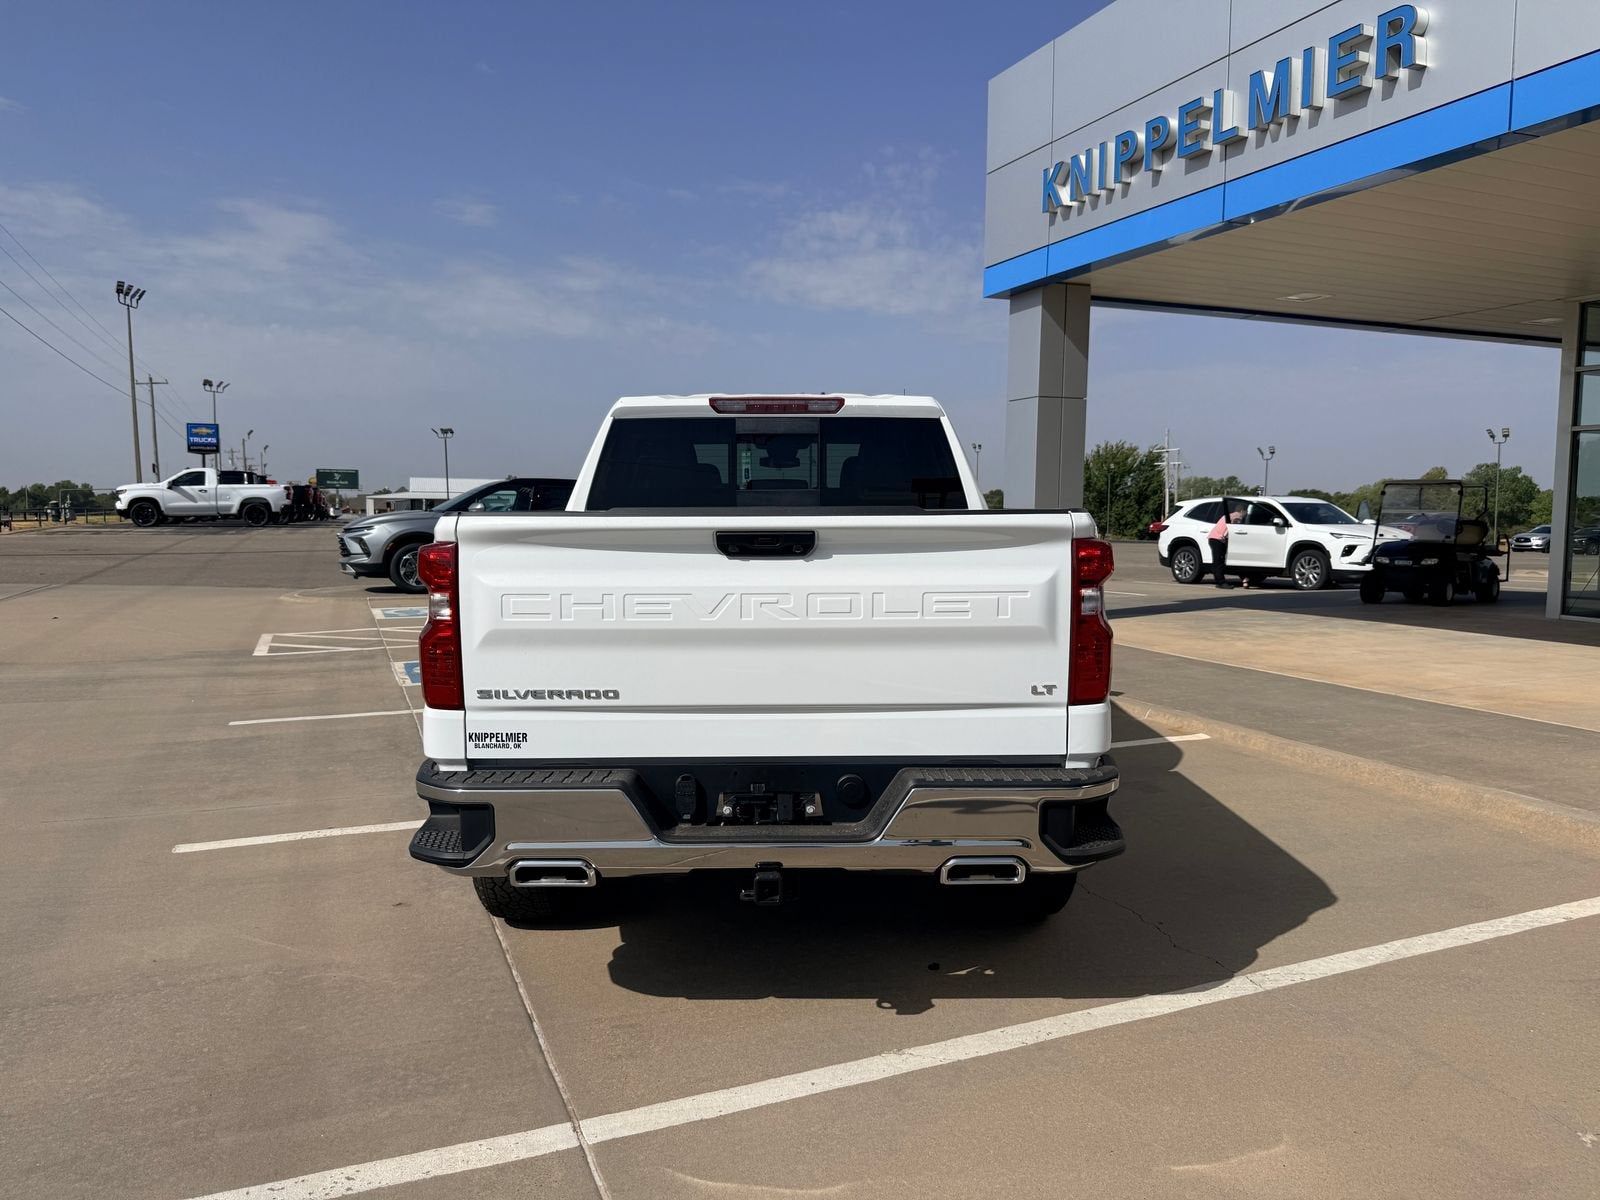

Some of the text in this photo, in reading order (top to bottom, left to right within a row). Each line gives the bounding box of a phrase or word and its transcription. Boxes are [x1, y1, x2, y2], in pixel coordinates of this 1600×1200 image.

[1042, 4, 1427, 214] KNIPPELMIER
[500, 590, 1031, 622] CHEVROLET
[476, 689, 620, 700] SILVERADO
[1031, 684, 1058, 696] LT
[468, 732, 528, 743] KNIPPELMIER
